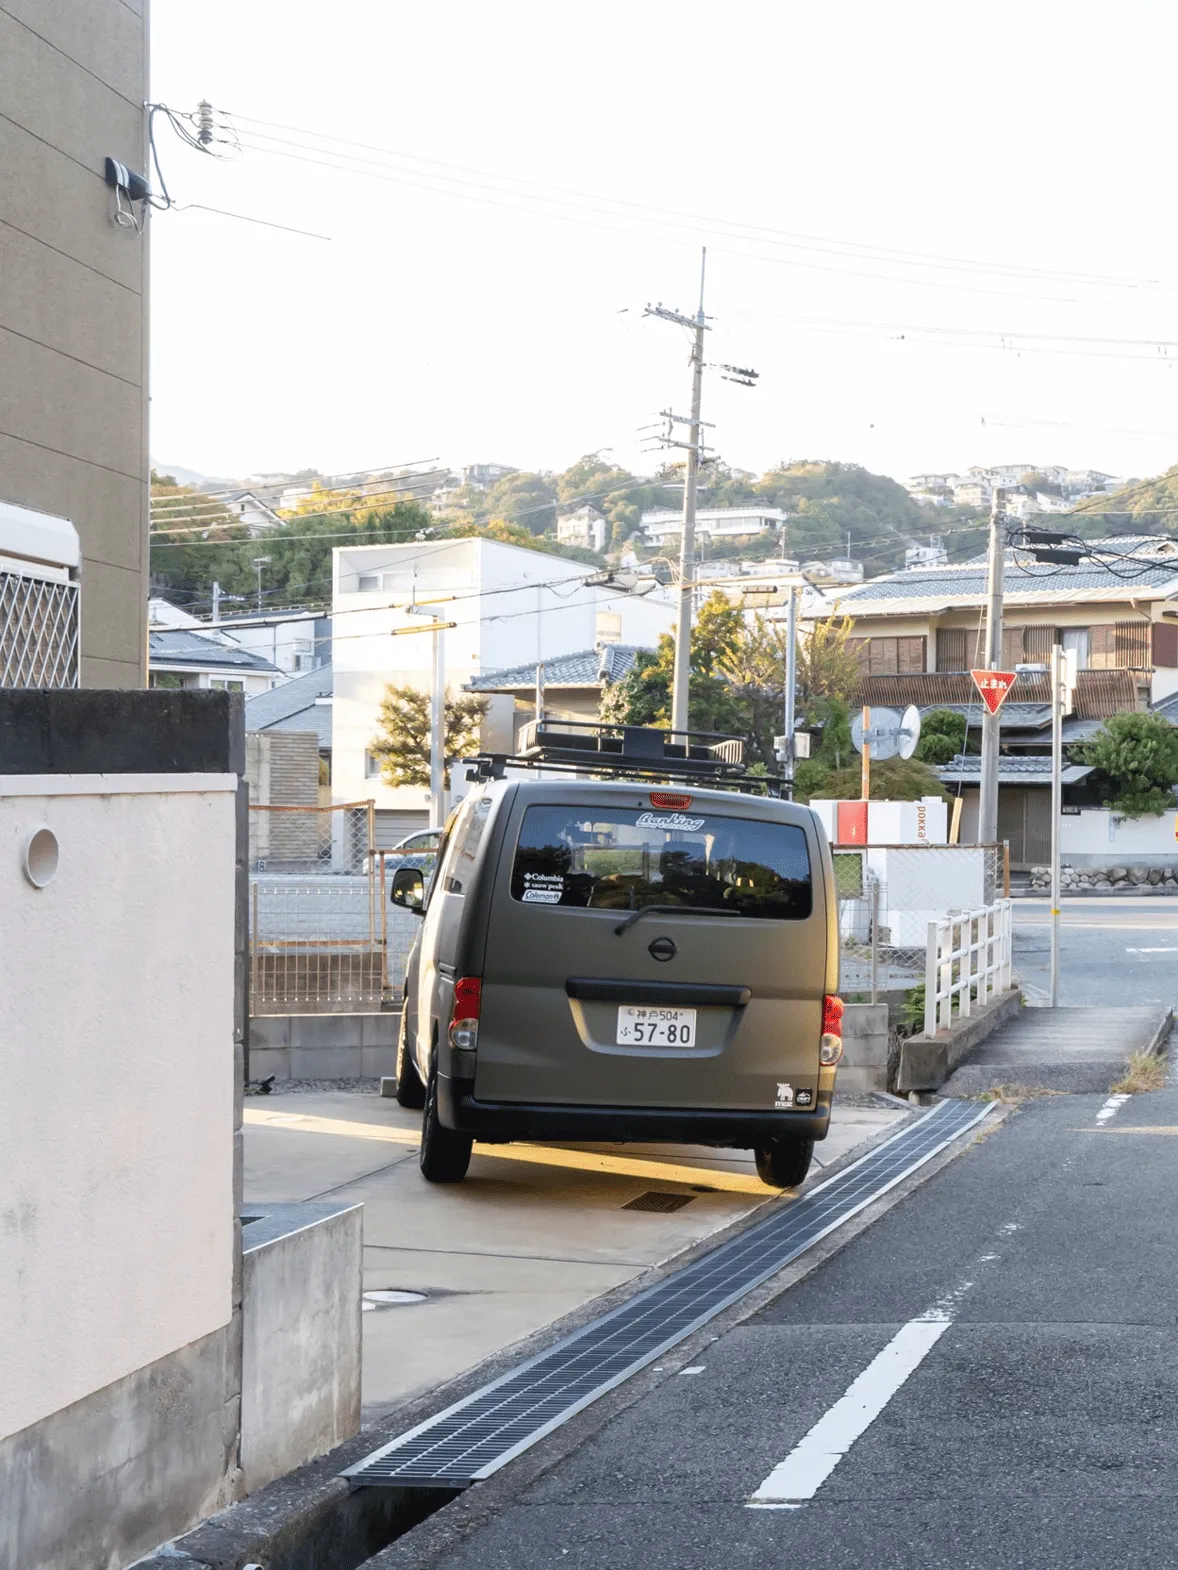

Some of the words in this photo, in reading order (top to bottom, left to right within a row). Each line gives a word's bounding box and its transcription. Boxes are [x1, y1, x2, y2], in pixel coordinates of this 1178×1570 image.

[980, 678, 1007, 689] 止まれ
[531, 873, 564, 882] Columbia
[525, 890, 554, 901] Coleman
[634, 1022, 690, 1044] 57-80
